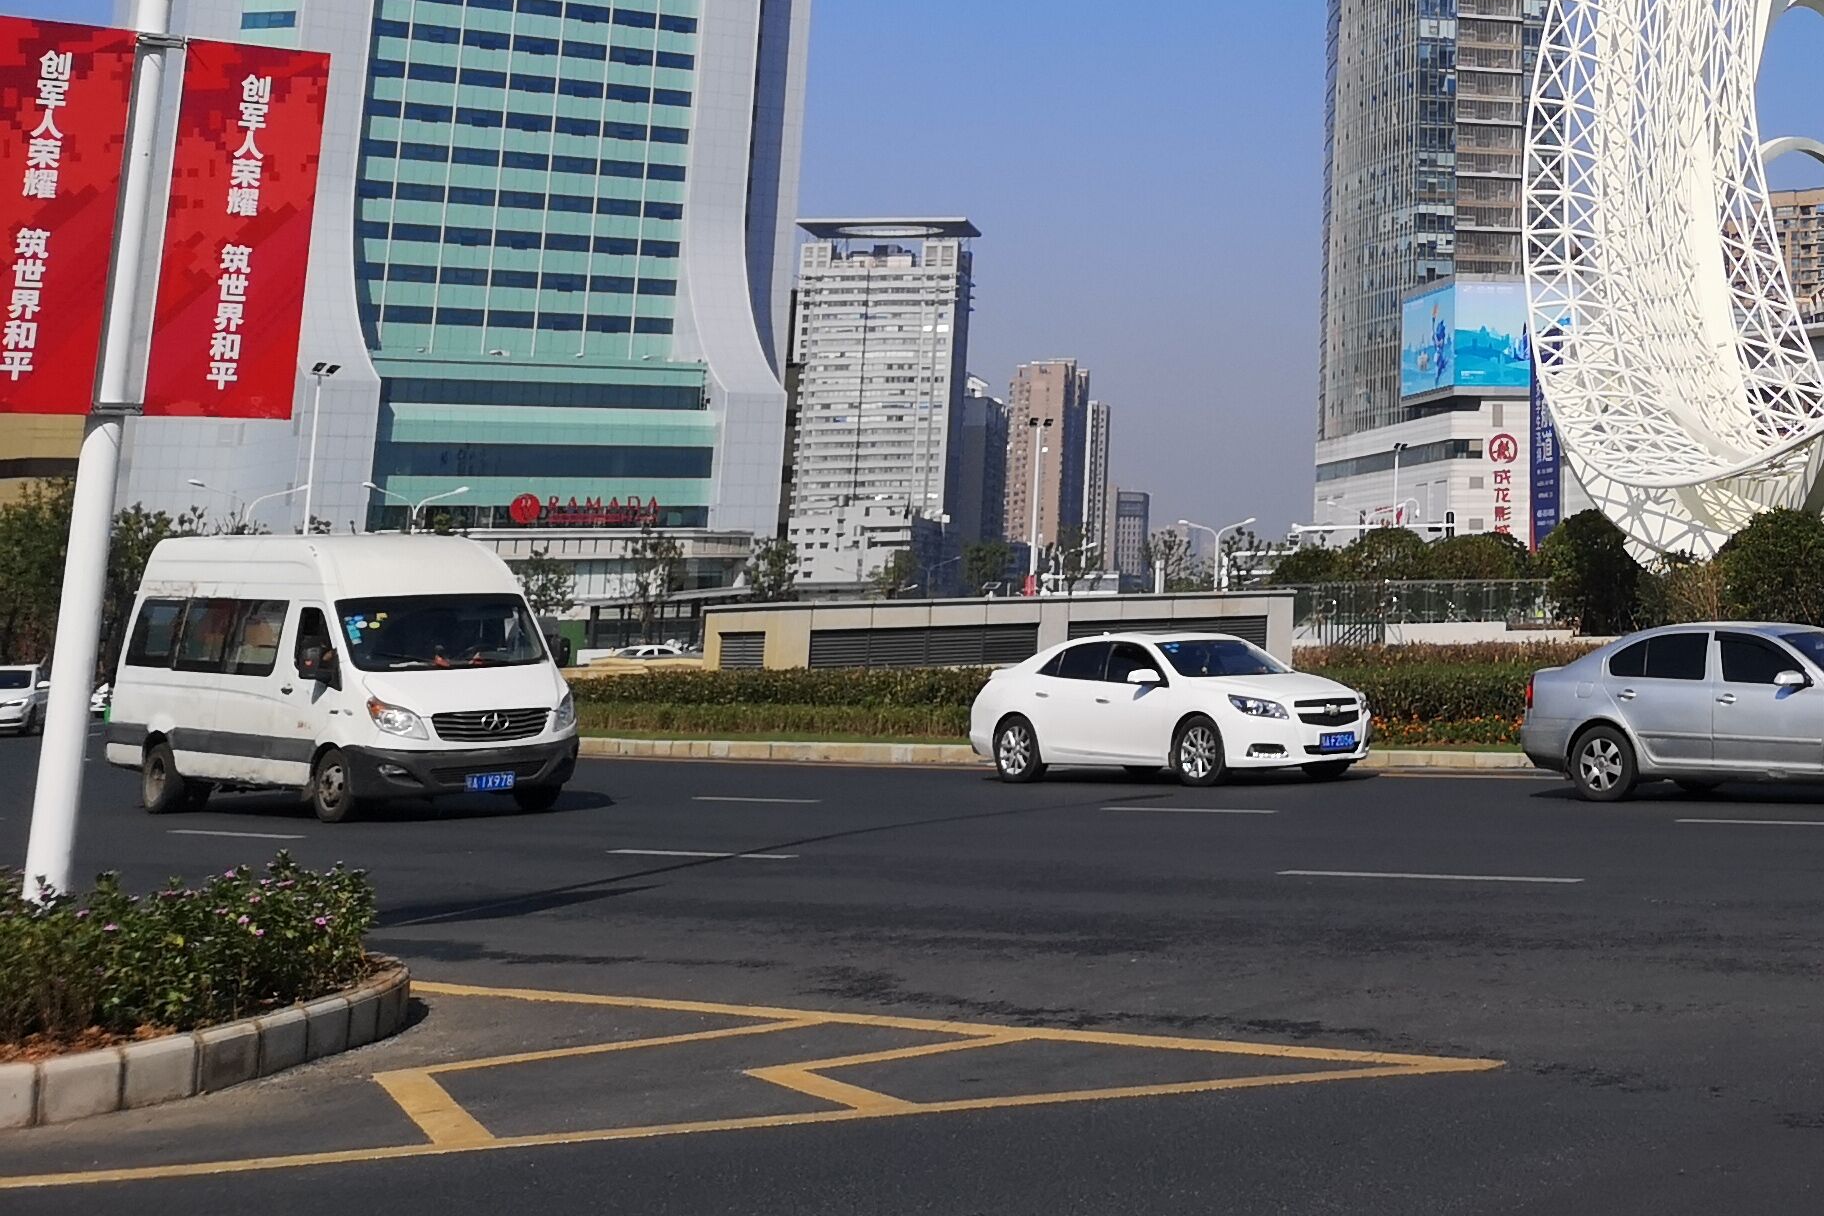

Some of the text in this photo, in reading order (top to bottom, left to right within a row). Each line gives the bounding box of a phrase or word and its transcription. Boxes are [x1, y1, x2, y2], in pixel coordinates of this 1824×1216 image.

[0, 49, 73, 381] 创军人荣耀 筑世界和平
[206, 74, 272, 390] 创军人荣耀 筑世界和平
[548, 495, 660, 515] RAMADA
